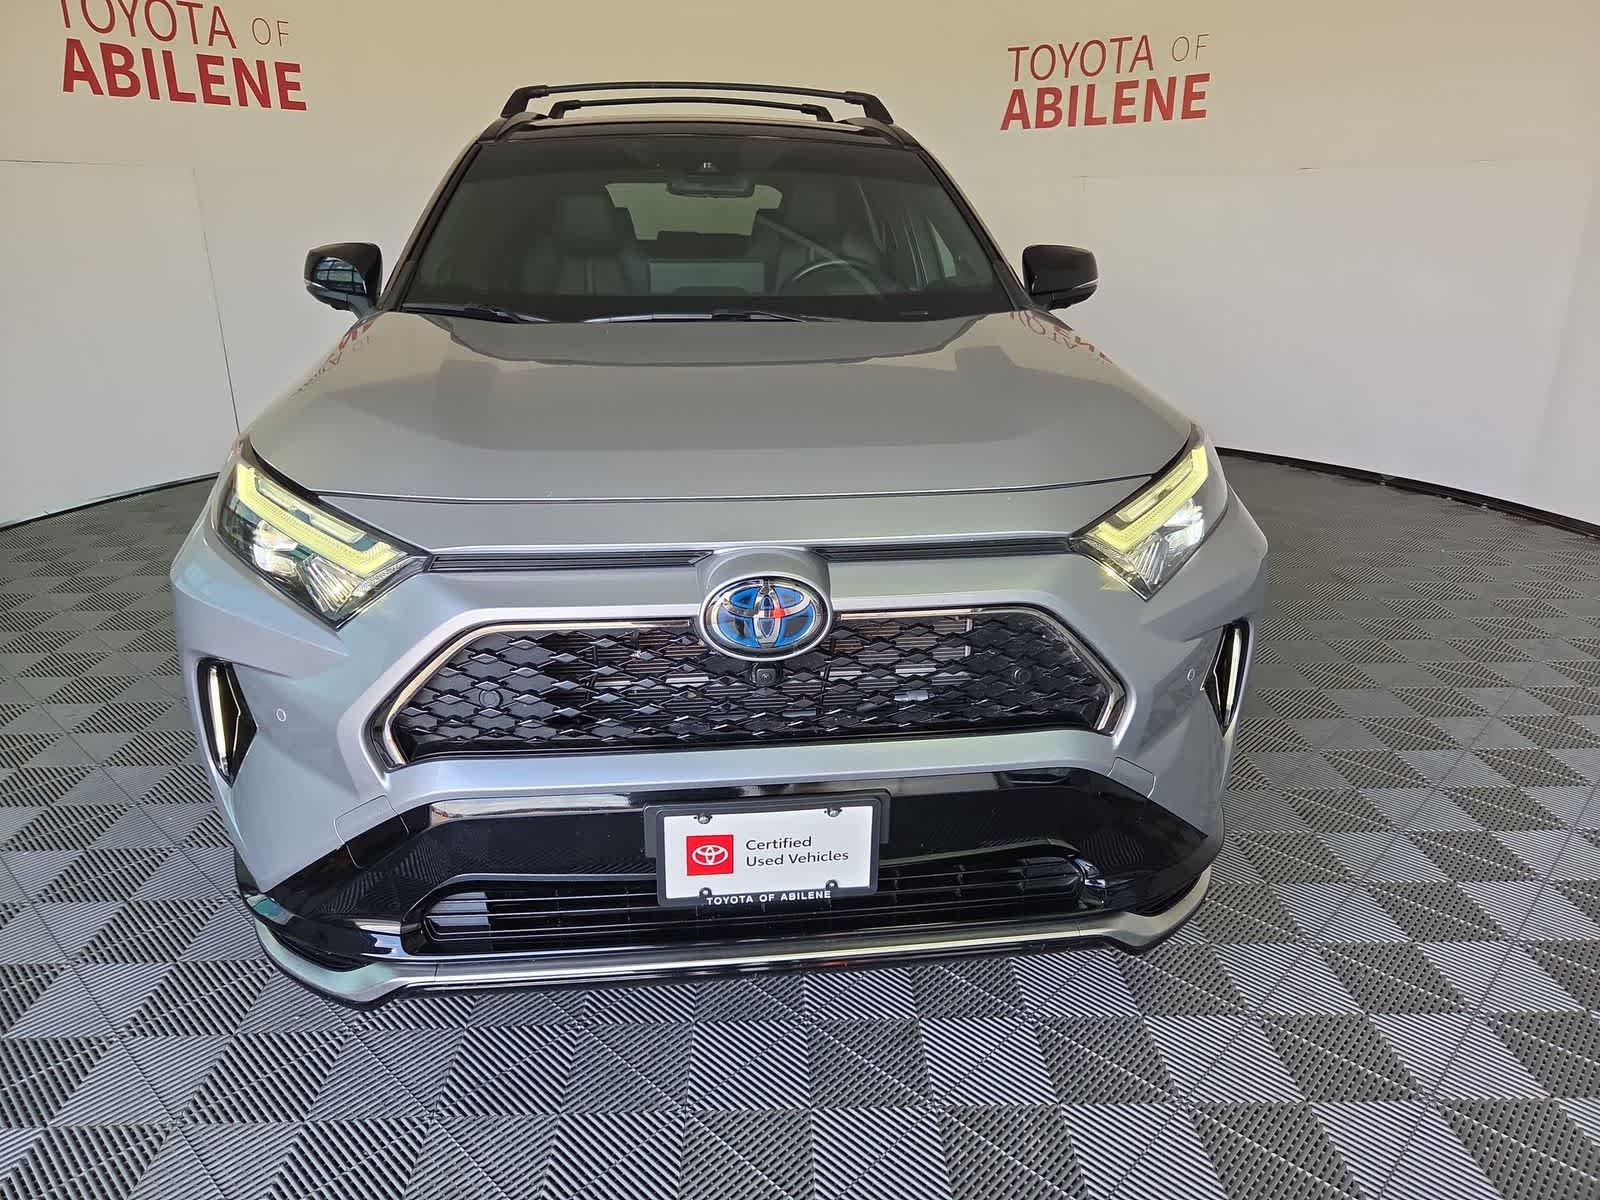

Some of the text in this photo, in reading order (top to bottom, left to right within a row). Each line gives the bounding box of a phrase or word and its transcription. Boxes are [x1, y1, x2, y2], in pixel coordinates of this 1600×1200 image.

[251, 17, 289, 47] OF
[1007, 33, 1209, 82] TOYOTA OF
[63, 38, 307, 111] ABILENE
[1000, 72, 1211, 131] ABILENE
[745, 836, 812, 850] Certified
[745, 851, 849, 867] Used Vehicles
[706, 890, 831, 906] TOYOTA OF ABILENE
